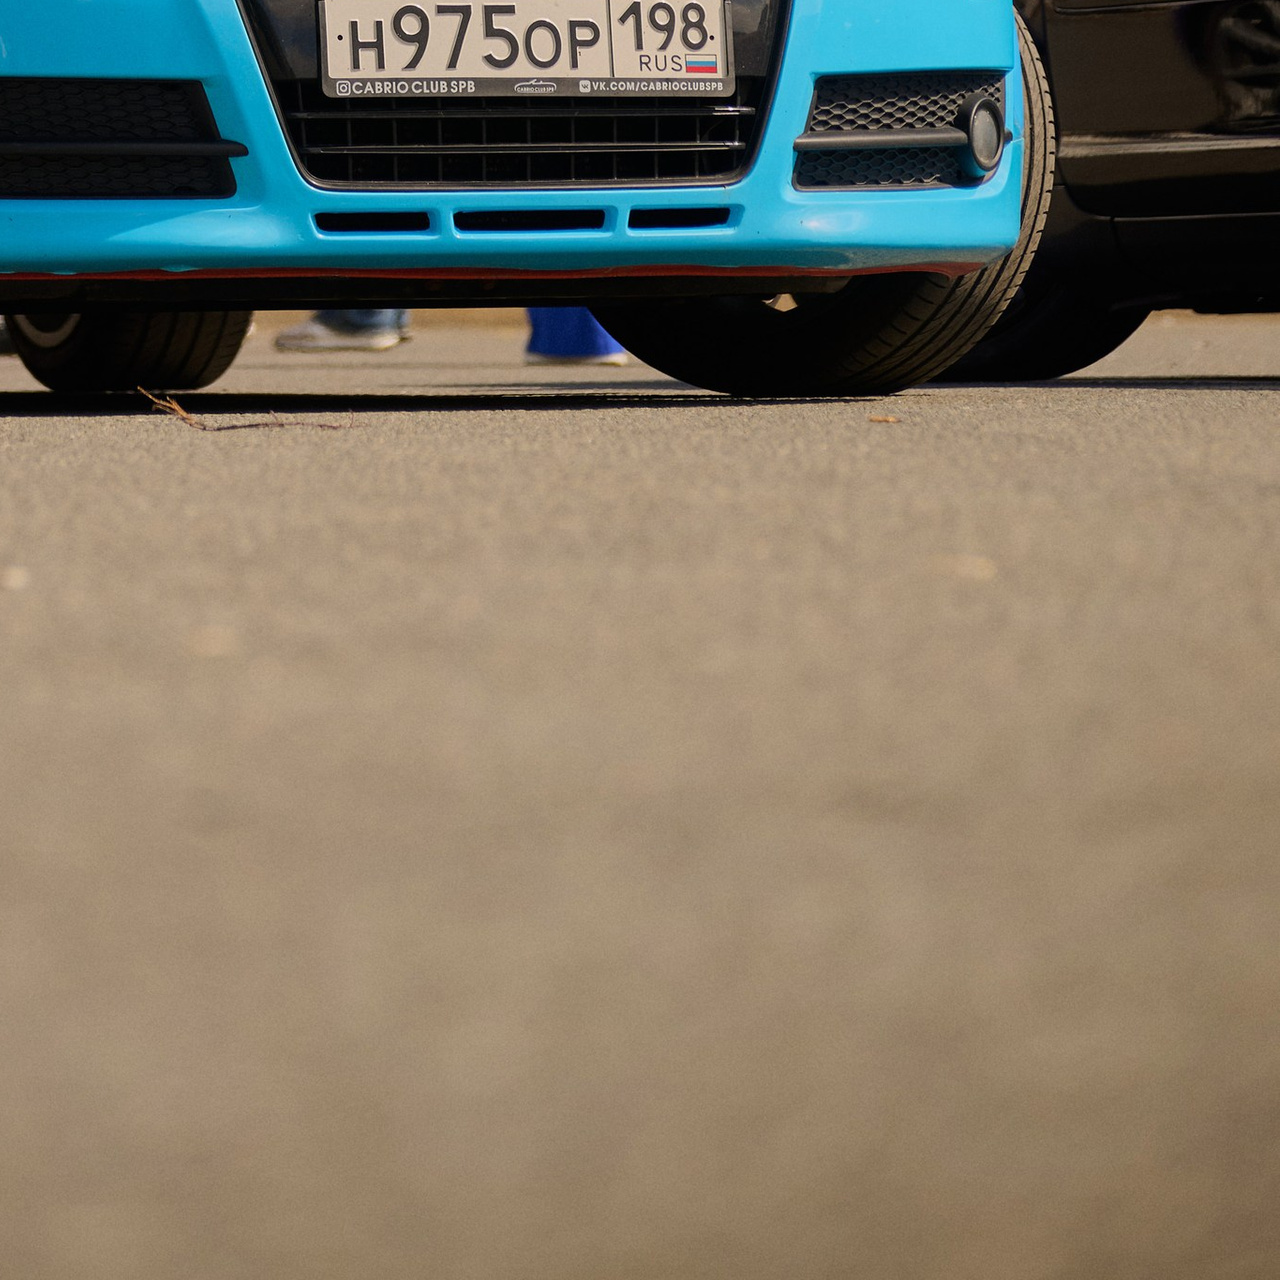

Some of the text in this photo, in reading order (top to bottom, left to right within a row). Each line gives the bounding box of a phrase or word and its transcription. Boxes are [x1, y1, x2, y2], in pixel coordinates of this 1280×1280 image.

[618, 1, 708, 51] 198
[639, 54, 683, 72] RUS
[352, 80, 476, 94] CABRIO CLUB SPB
[592, 80, 724, 92] VK.COM/CABRIOCLUBSPB
